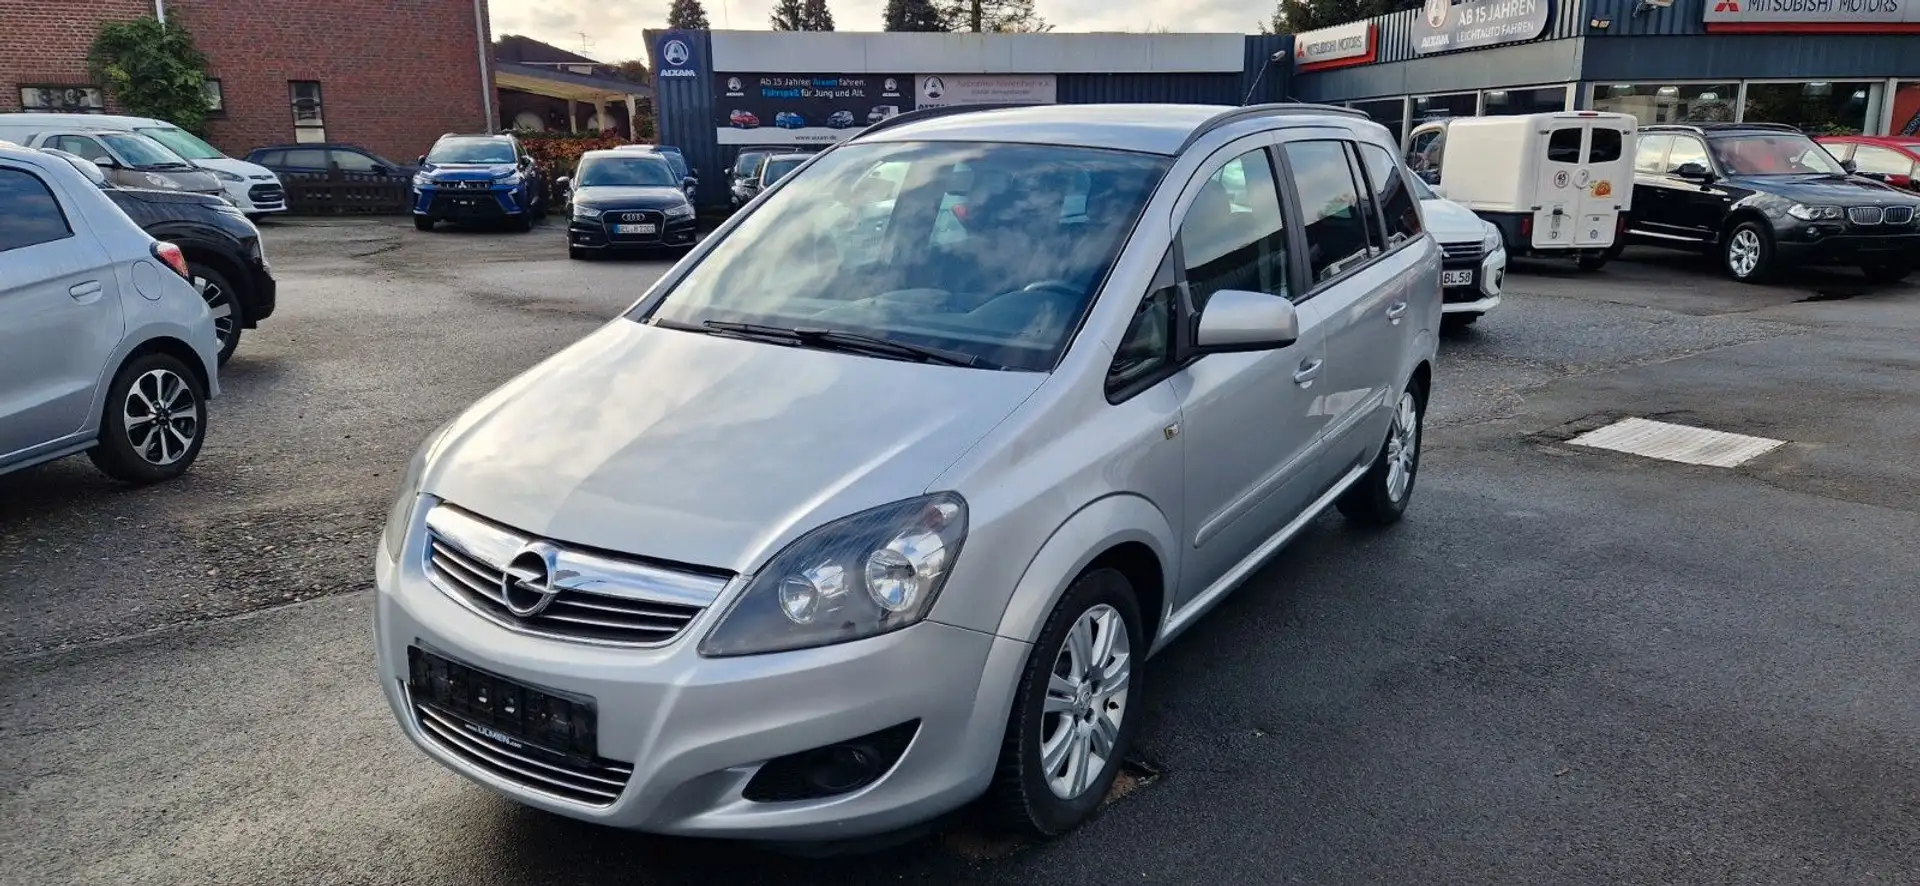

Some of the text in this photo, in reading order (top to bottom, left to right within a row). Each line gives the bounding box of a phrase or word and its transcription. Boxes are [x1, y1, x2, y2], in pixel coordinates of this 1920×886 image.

[1747, 0, 1898, 12] MITSUBISHI MOTORS
[1458, 0, 1536, 26] AB 15 JAHREN
[1456, 21, 1534, 43] LEICHTAUTO FAHREN
[1338, 36, 1362, 52] MOTORS
[660, 69, 696, 77] AIXAM
[760, 78, 771, 86] Ab
[773, 78, 782, 86] 15
[784, 77, 811, 86] Jahren
[801, 88, 812, 97] für
[814, 89, 833, 99] Jung
[835, 88, 850, 97] und
[1459, 271, 1471, 283] 58
